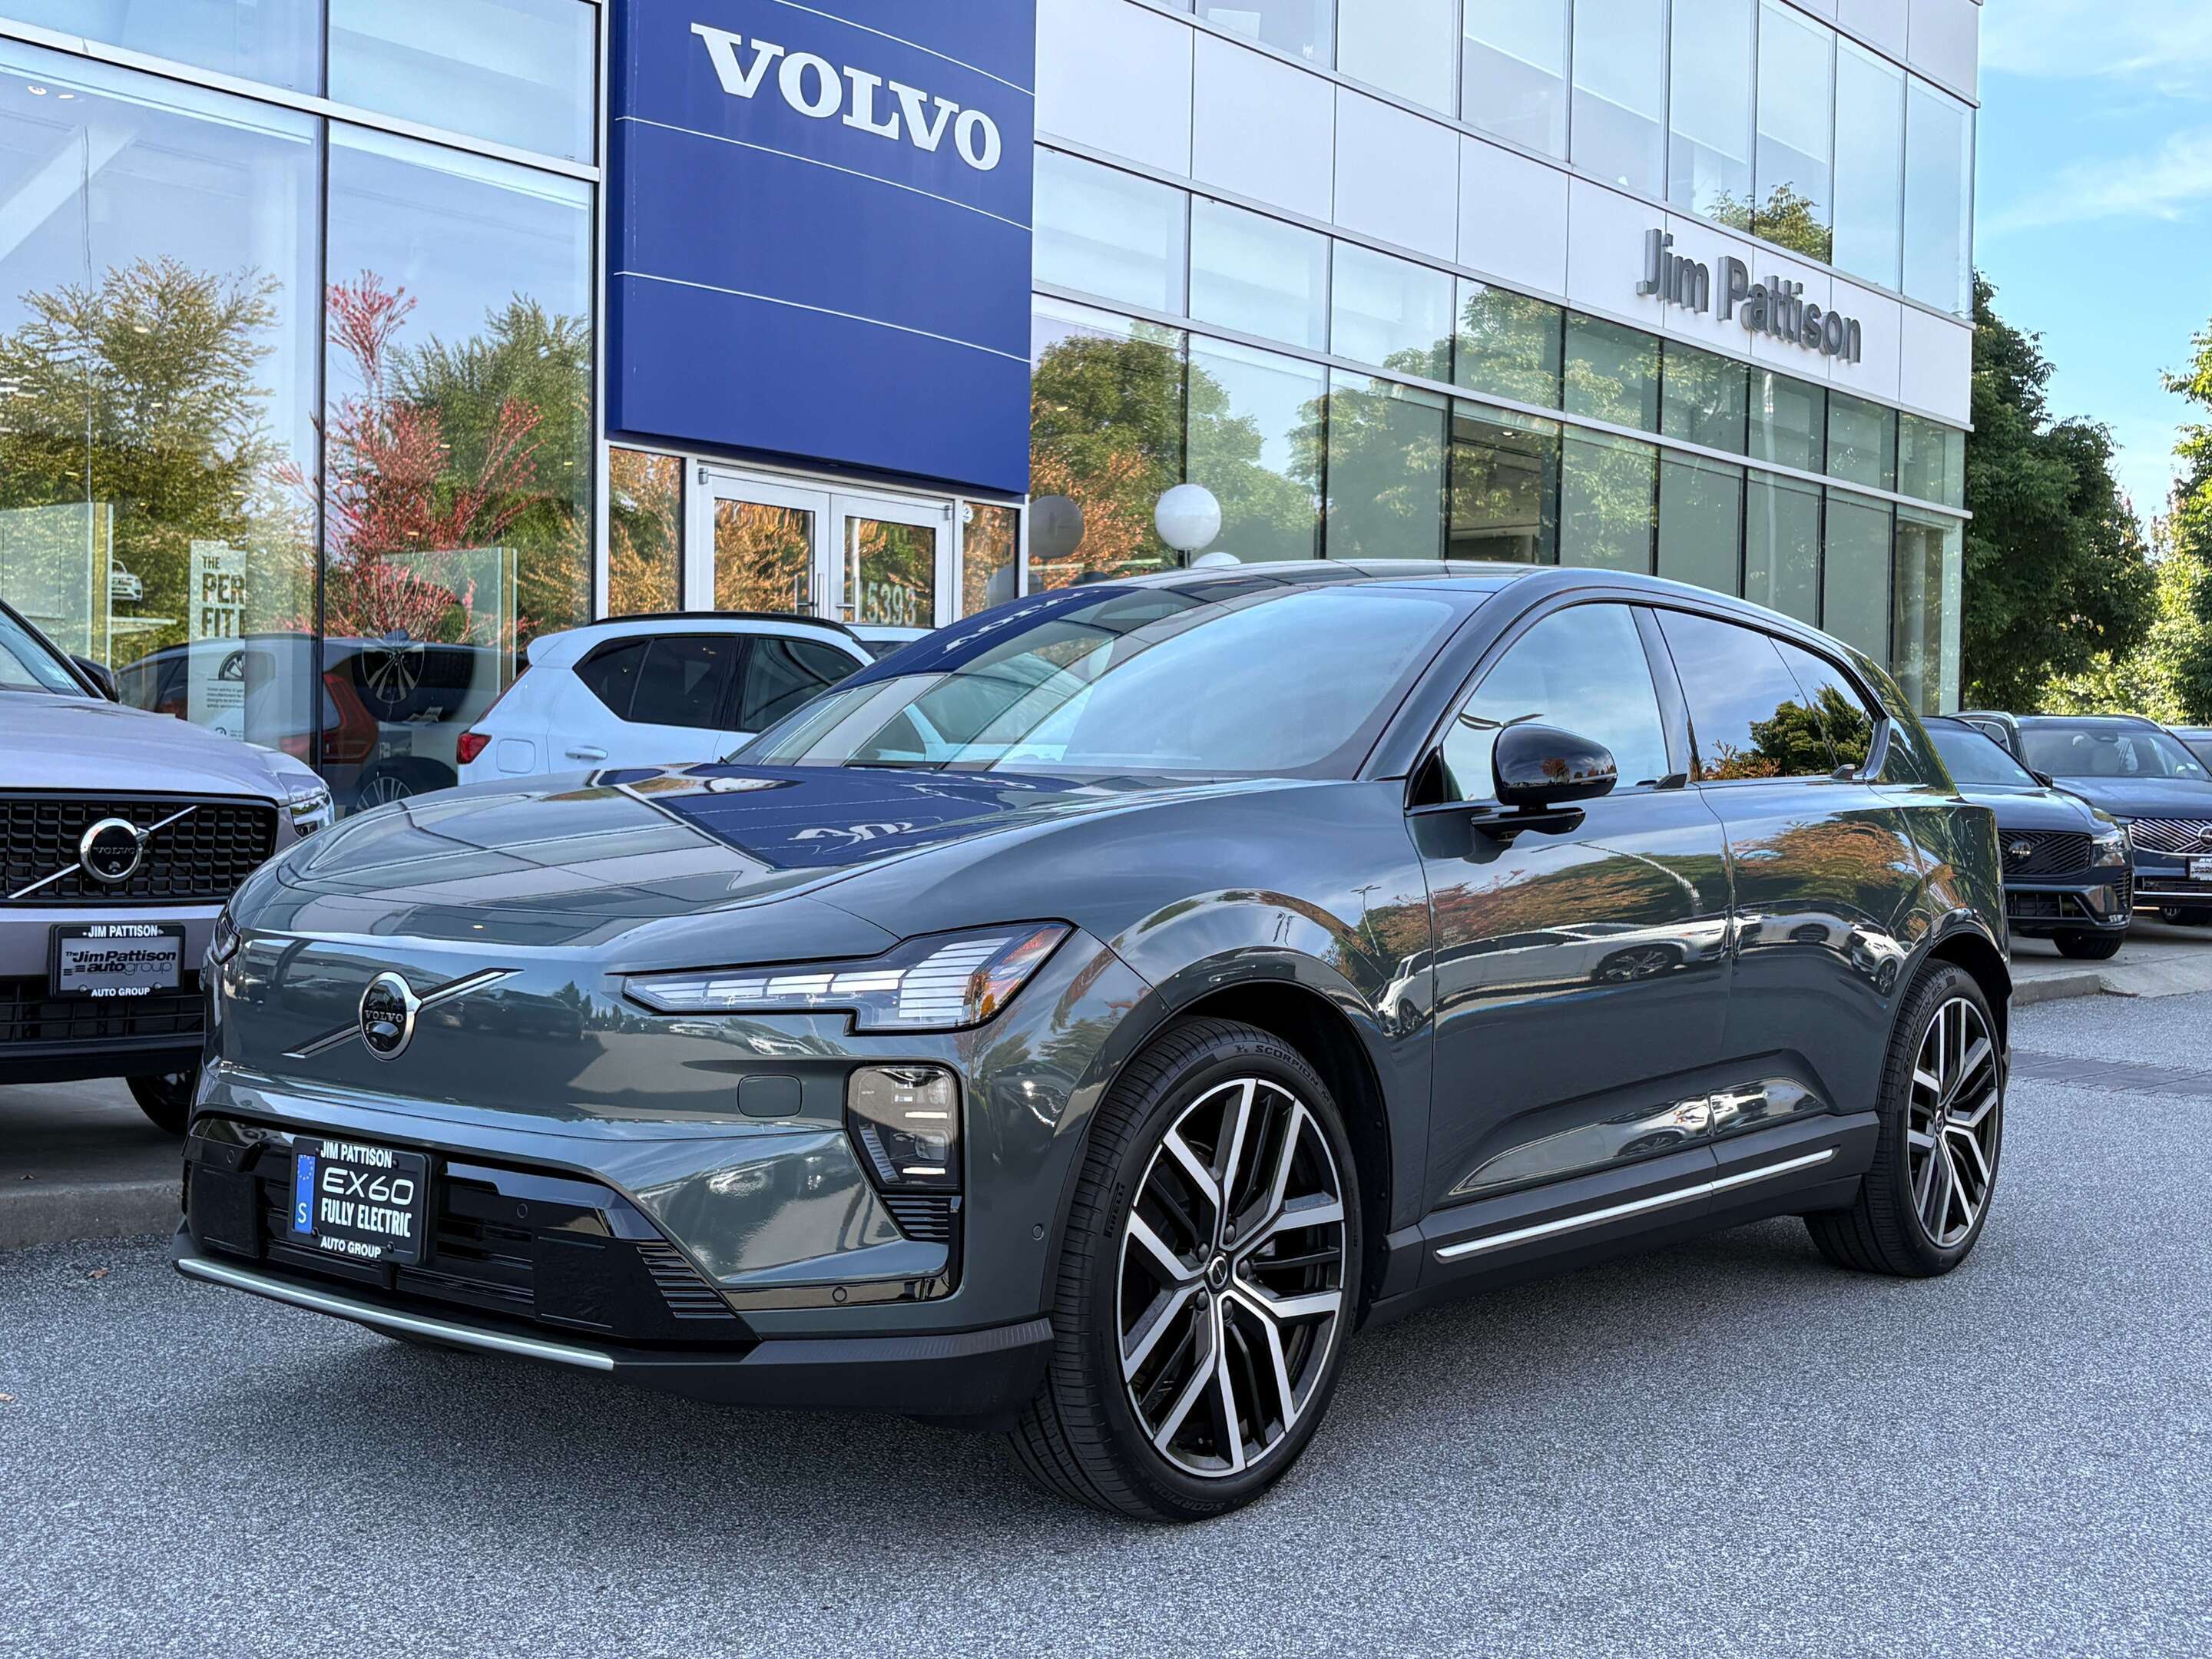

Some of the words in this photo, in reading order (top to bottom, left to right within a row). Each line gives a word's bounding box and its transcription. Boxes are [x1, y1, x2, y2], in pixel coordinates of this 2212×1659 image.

[690, 22, 1002, 171] VOLVO
[1636, 228, 1709, 314] Jim
[1717, 256, 1862, 363] Pattison
[202, 556, 220, 569] THE
[88, 926, 107, 938] JIM
[109, 924, 158, 937] PATTISON
[91, 988, 116, 998] AUTO
[118, 986, 151, 997] GROUP
[364, 1009, 404, 1024] VOLVO
[1254, 1044, 1320, 1087] SCORPION
[320, 1141, 339, 1160] JIM
[340, 1144, 392, 1169] PATTISON
[322, 1167, 414, 1206] EX60
[297, 1202, 308, 1224] S
[320, 1197, 356, 1227] FULLY
[356, 1204, 412, 1238] ELECTRIC
[320, 1235, 346, 1252] AUTO
[347, 1240, 382, 1259] GROUP
